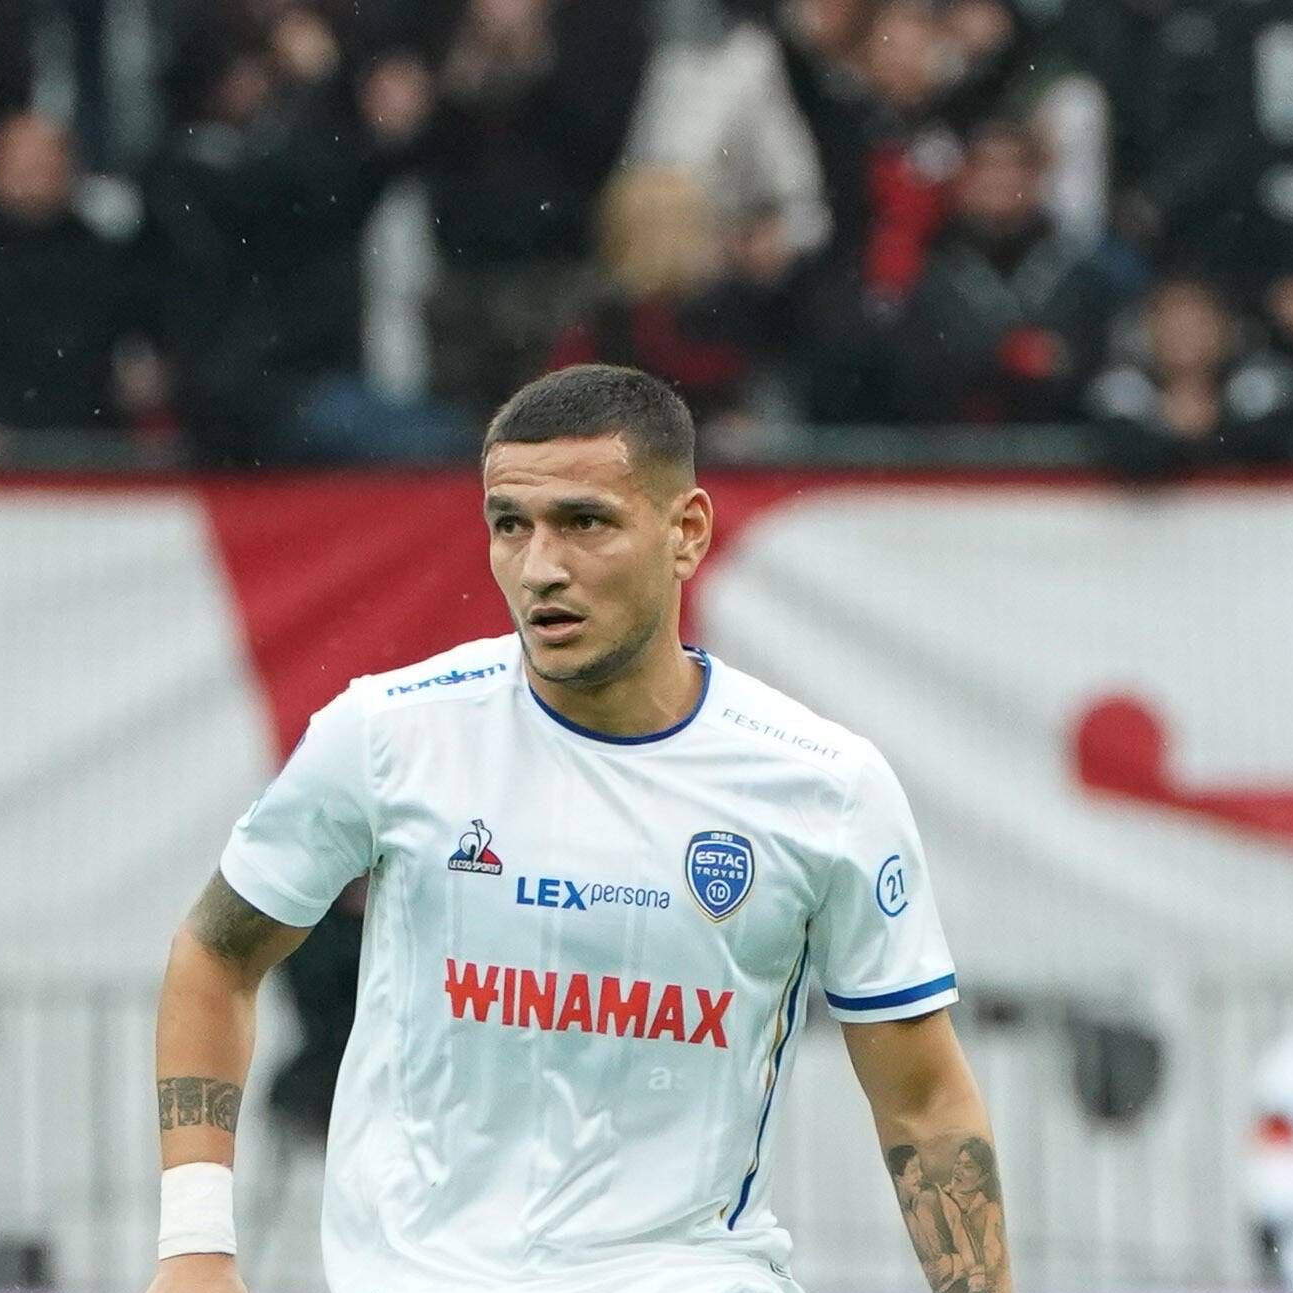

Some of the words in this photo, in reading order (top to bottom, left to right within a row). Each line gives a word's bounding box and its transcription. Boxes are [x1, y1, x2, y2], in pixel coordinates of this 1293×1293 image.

[721, 707, 843, 760] FESTILIGHT
[695, 851, 746, 869] ESTAC
[694, 866, 744, 880] TROYES
[710, 885, 726, 900] 10
[445, 958, 735, 1049] WINAMAX
